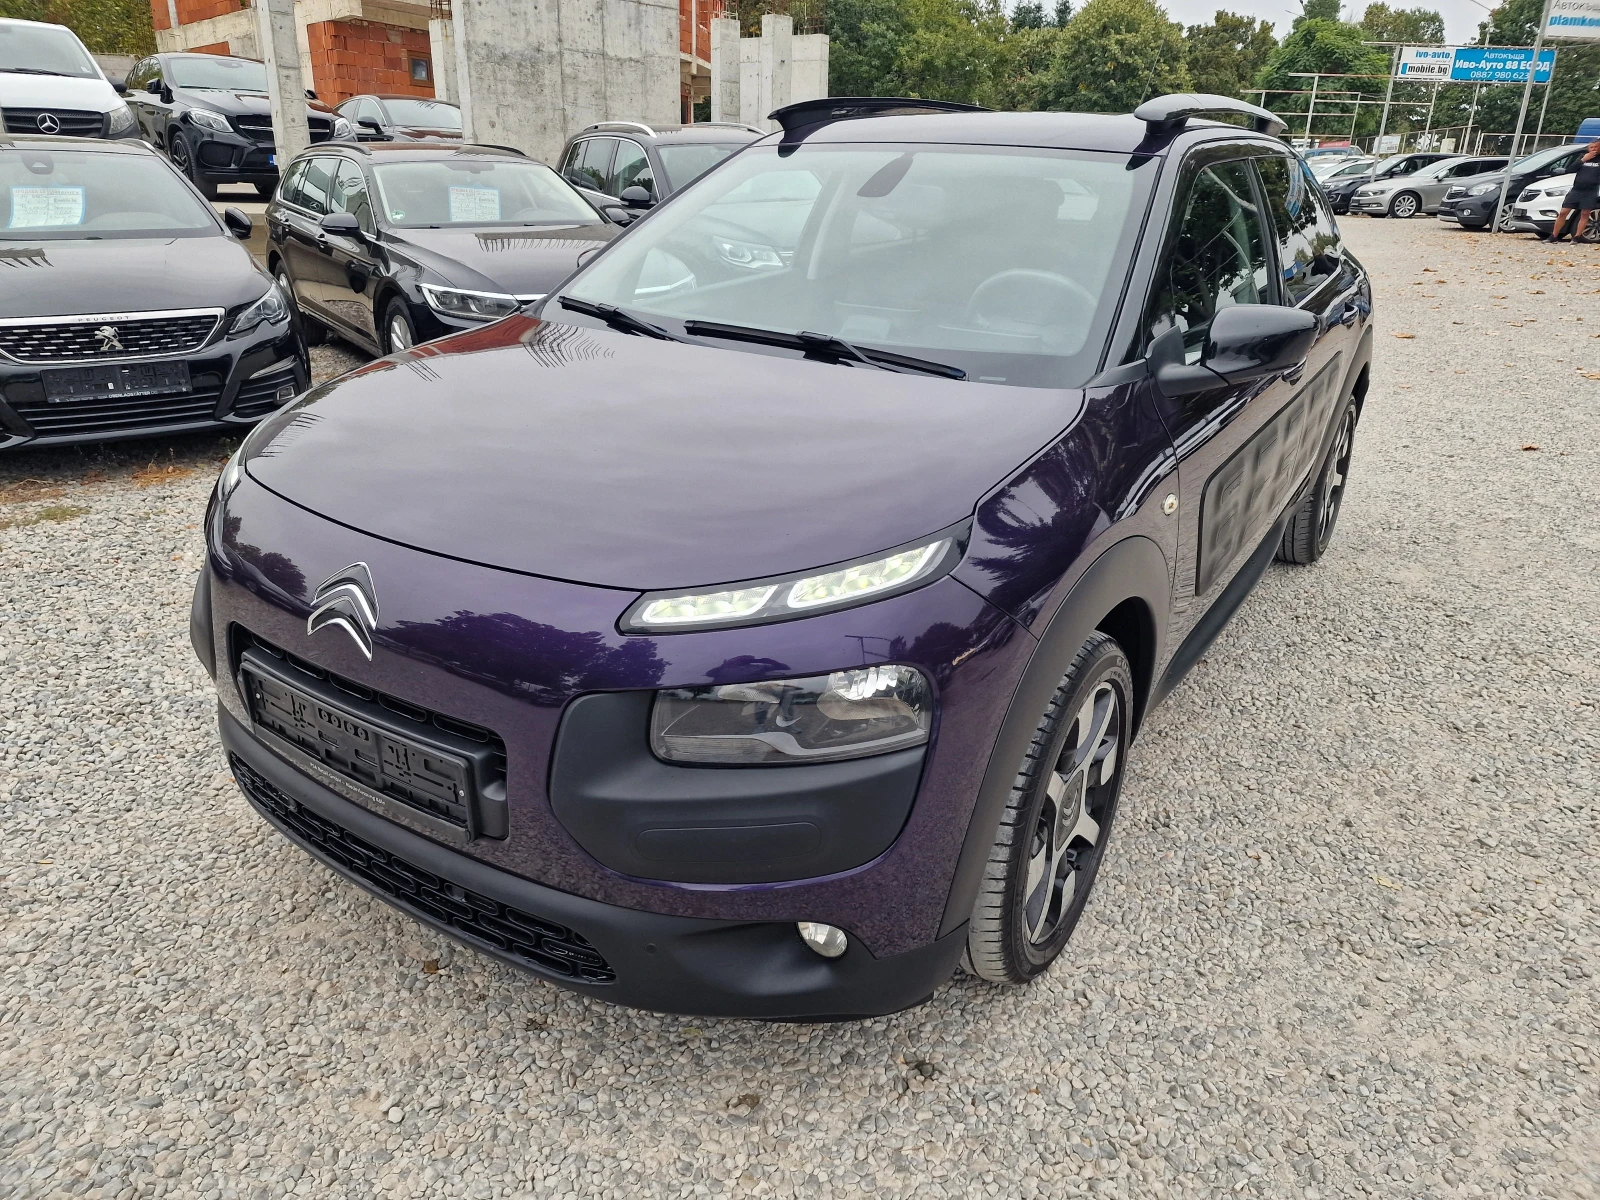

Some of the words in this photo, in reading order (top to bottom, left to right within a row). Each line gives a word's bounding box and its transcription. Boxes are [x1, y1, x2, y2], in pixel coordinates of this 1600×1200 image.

[1483, 52, 1525, 60] Автокъща
[1455, 60, 1504, 71] Иво-Ауто
[1505, 61, 1518, 70] 88
[1494, 71, 1512, 79] 980
